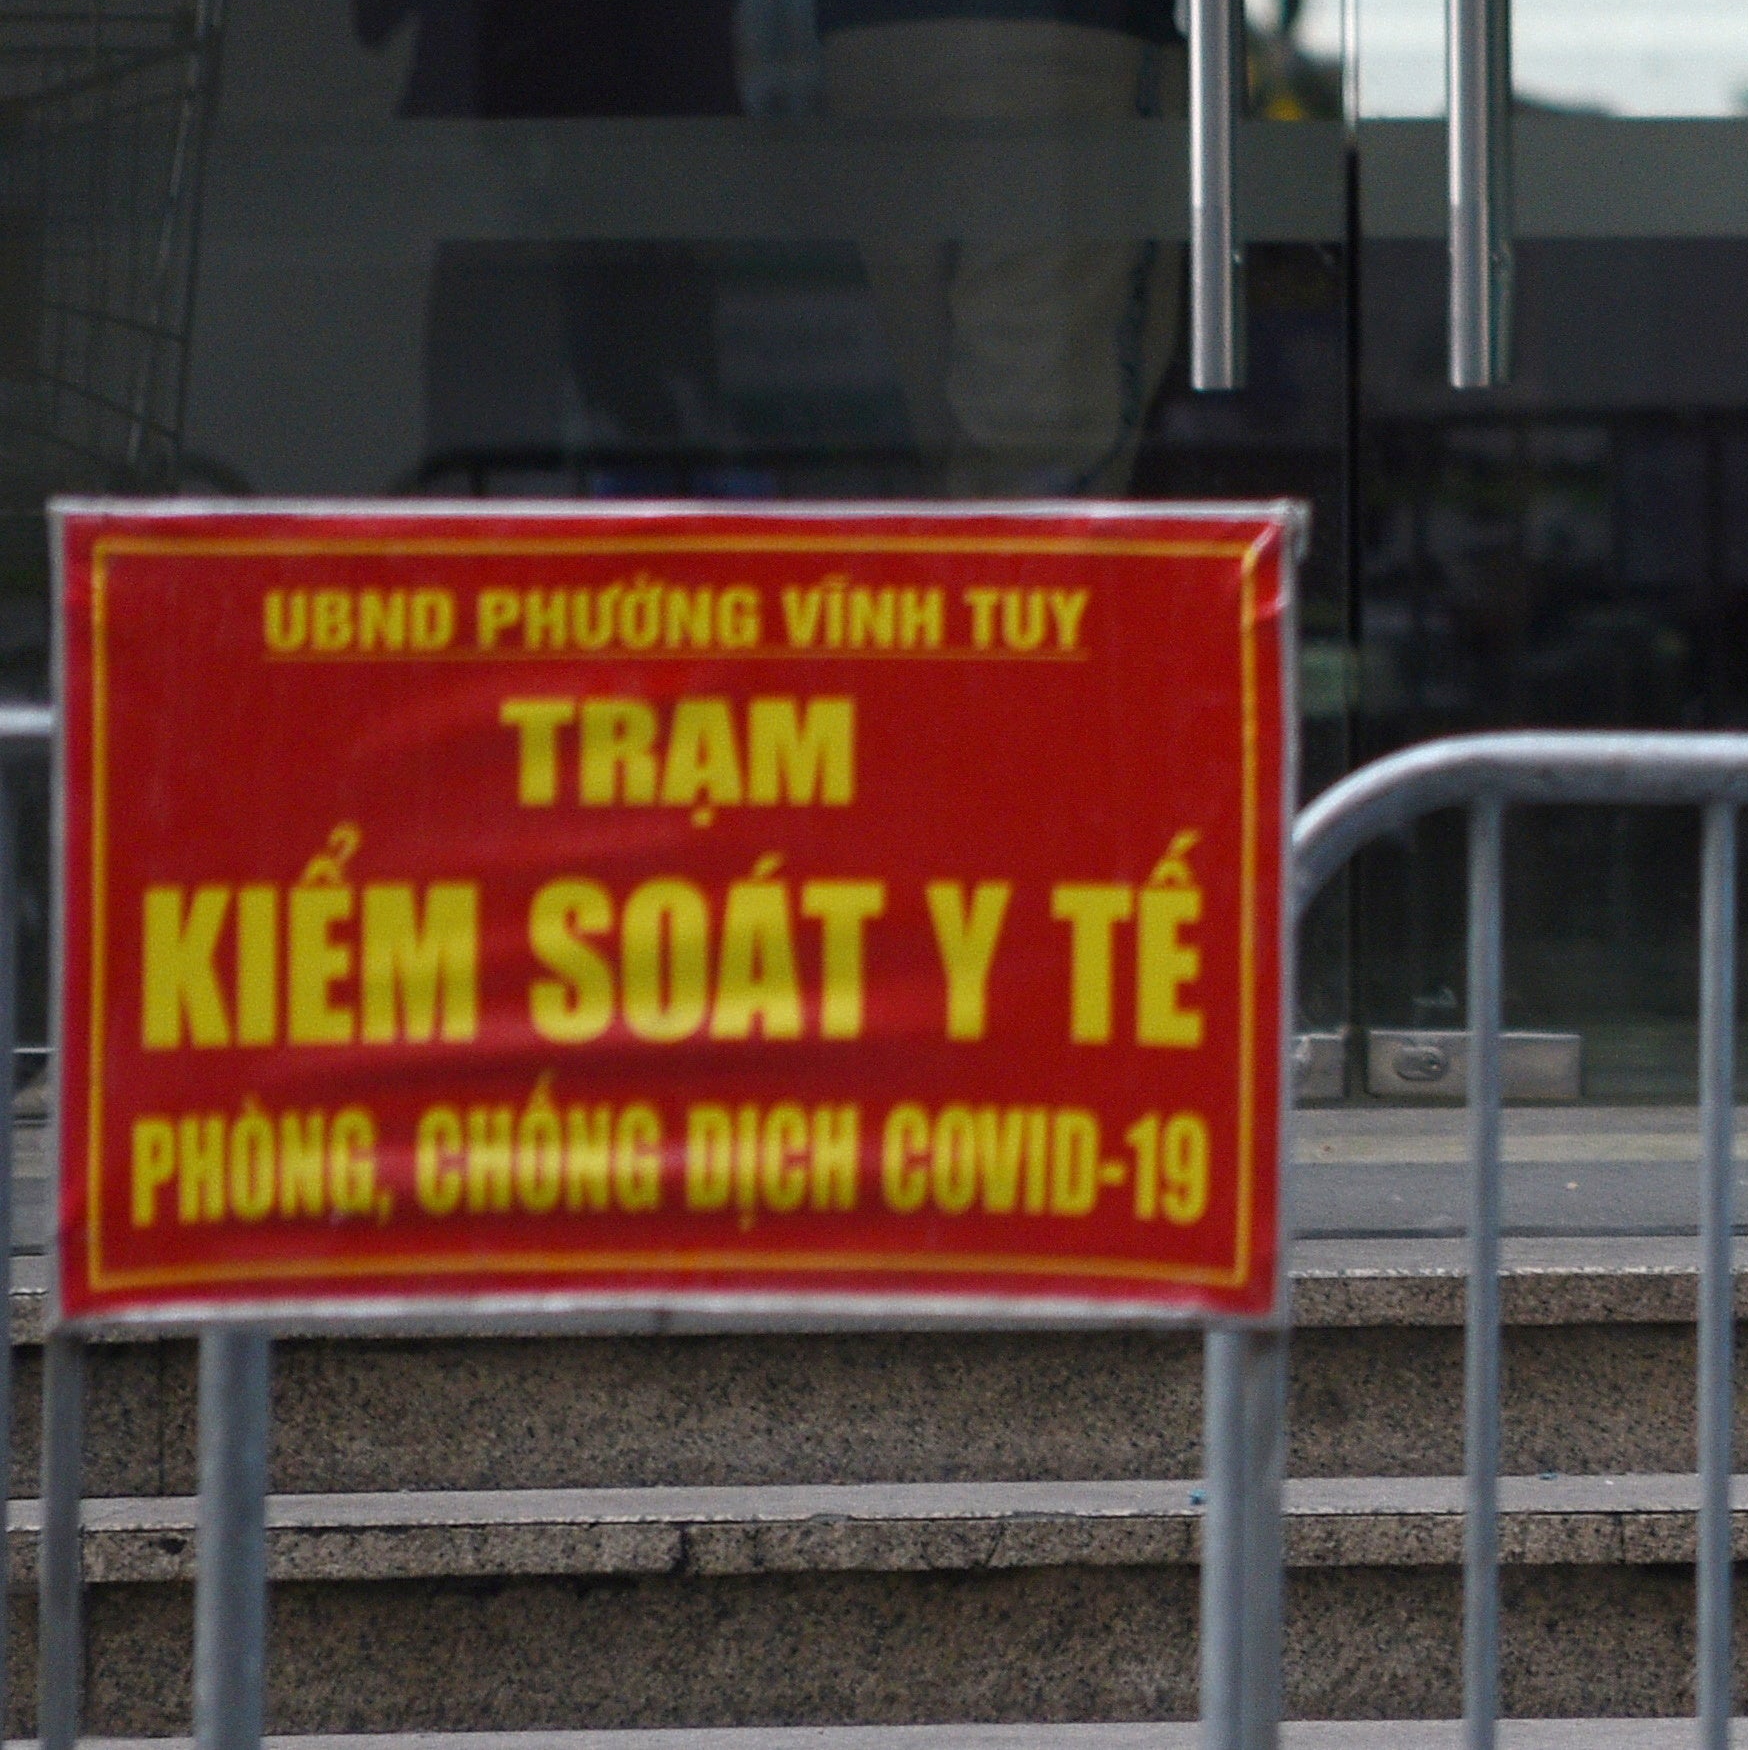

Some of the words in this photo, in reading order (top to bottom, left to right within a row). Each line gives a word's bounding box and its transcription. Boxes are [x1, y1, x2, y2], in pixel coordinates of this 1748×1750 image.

[264, 587, 454, 651] UBND
[477, 574, 758, 650] PHƯỜNG
[780, 575, 943, 649] VĨNH
[966, 587, 1090, 649] TUY
[500, 698, 855, 828] TRẠM
[141, 824, 480, 1050] KIỂM
[528, 856, 884, 1044] SOÁT
[926, 882, 1010, 1044] Y
[1051, 830, 1204, 1048] TẾ
[130, 1095, 393, 1229] PHÒNG,
[415, 1073, 667, 1216] CHỐNG
[685, 1104, 860, 1231] DỊCH
[880, 1104, 1209, 1225] COVID-19
